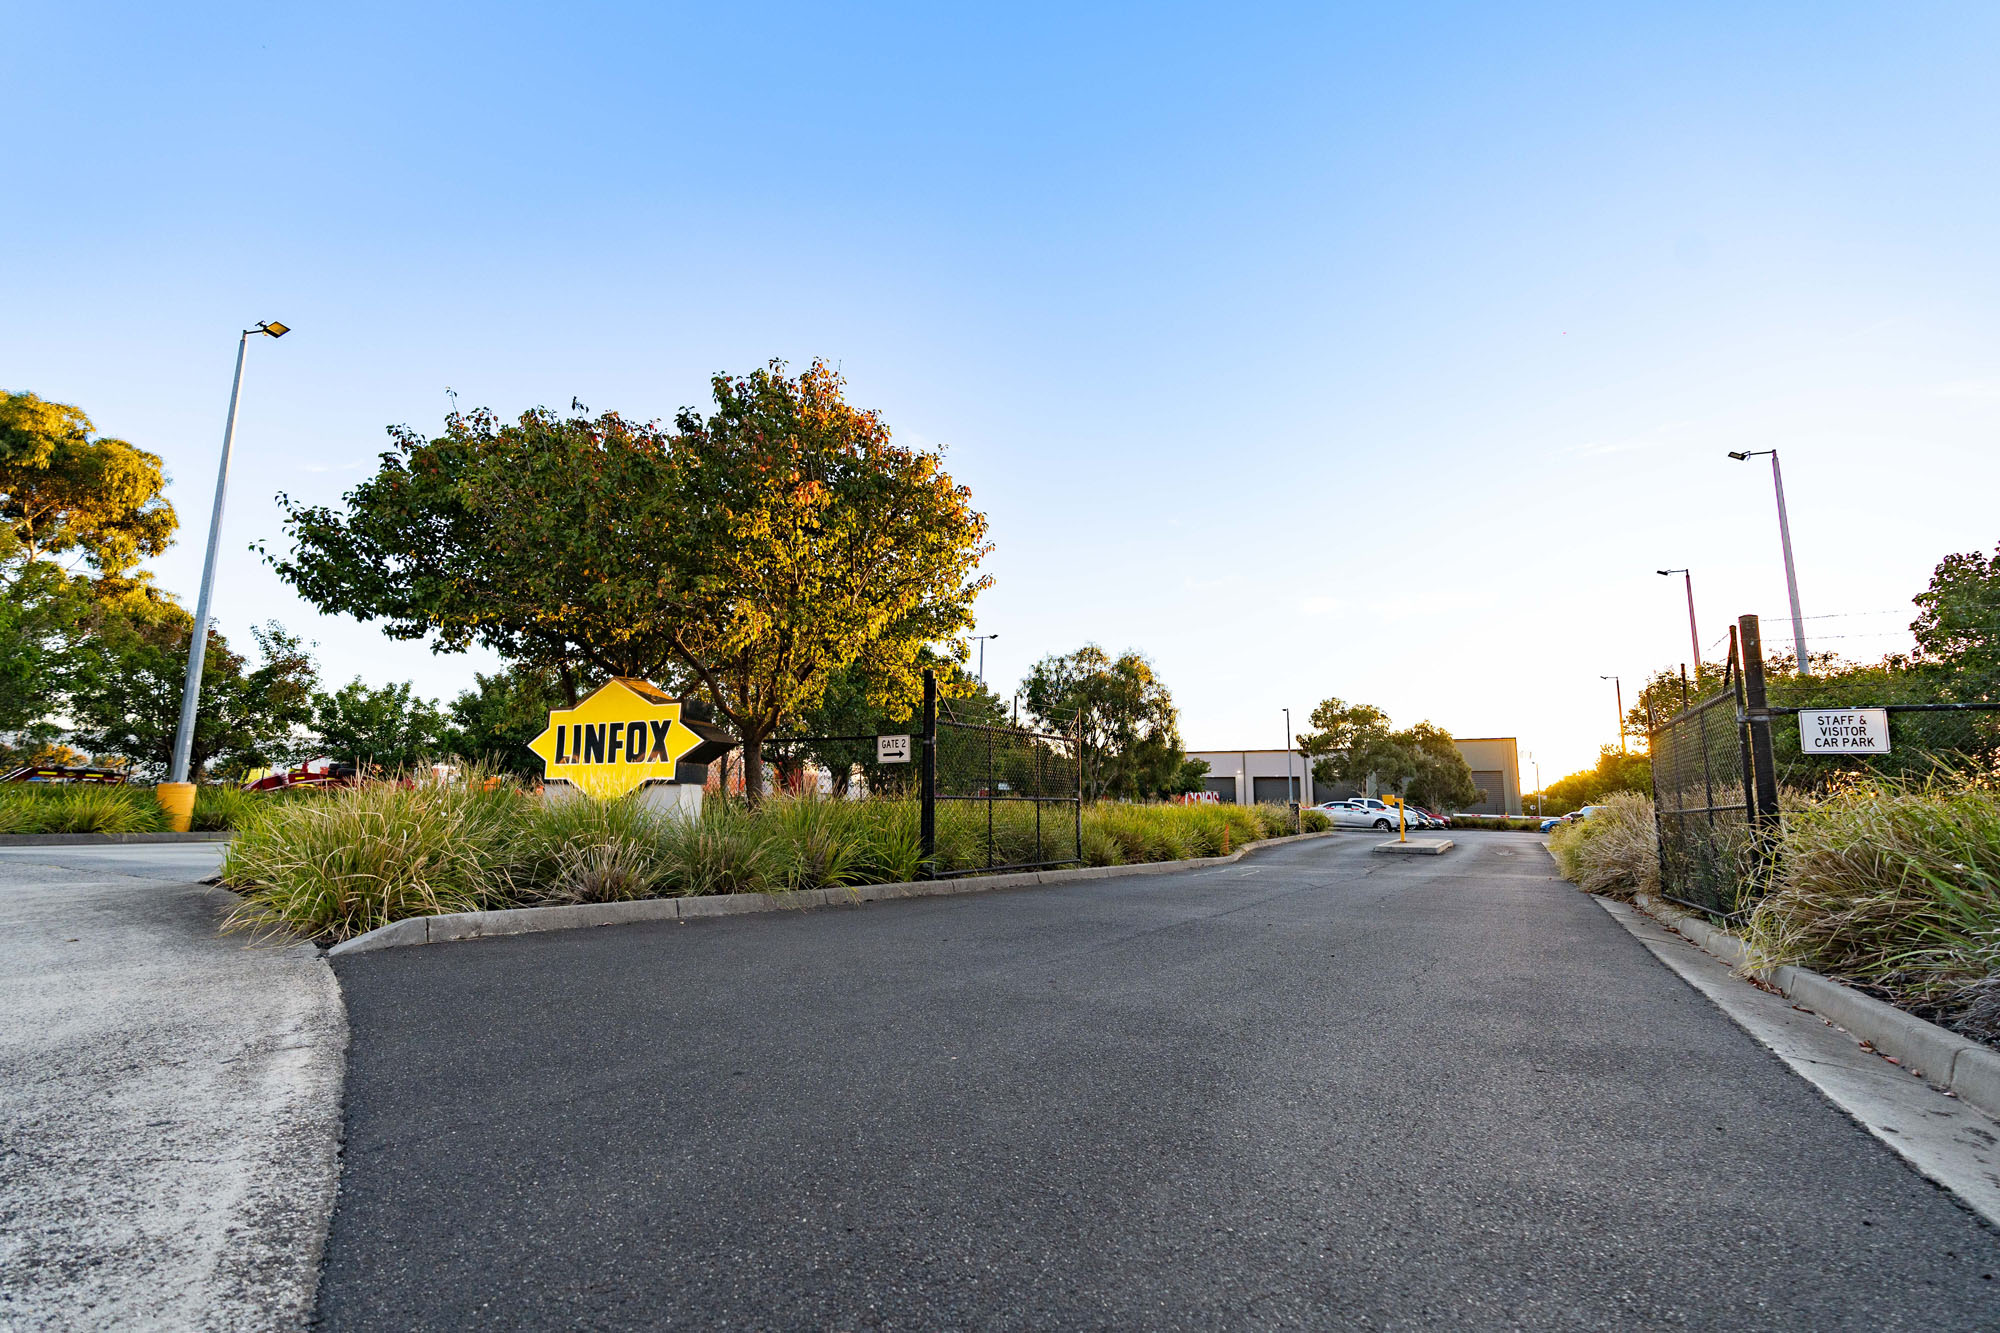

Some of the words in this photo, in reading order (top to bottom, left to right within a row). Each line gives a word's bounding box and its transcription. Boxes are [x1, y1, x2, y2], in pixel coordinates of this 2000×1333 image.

[1818, 716, 1854, 725] STAFF
[1859, 715, 1867, 725] &
[1820, 726, 1866, 736] VISITOR
[554, 719, 672, 765] LINFOX
[882, 739, 899, 748] GATE
[902, 739, 906, 747] 2
[1814, 738, 1838, 747] CAR
[1843, 737, 1875, 747] PARK
